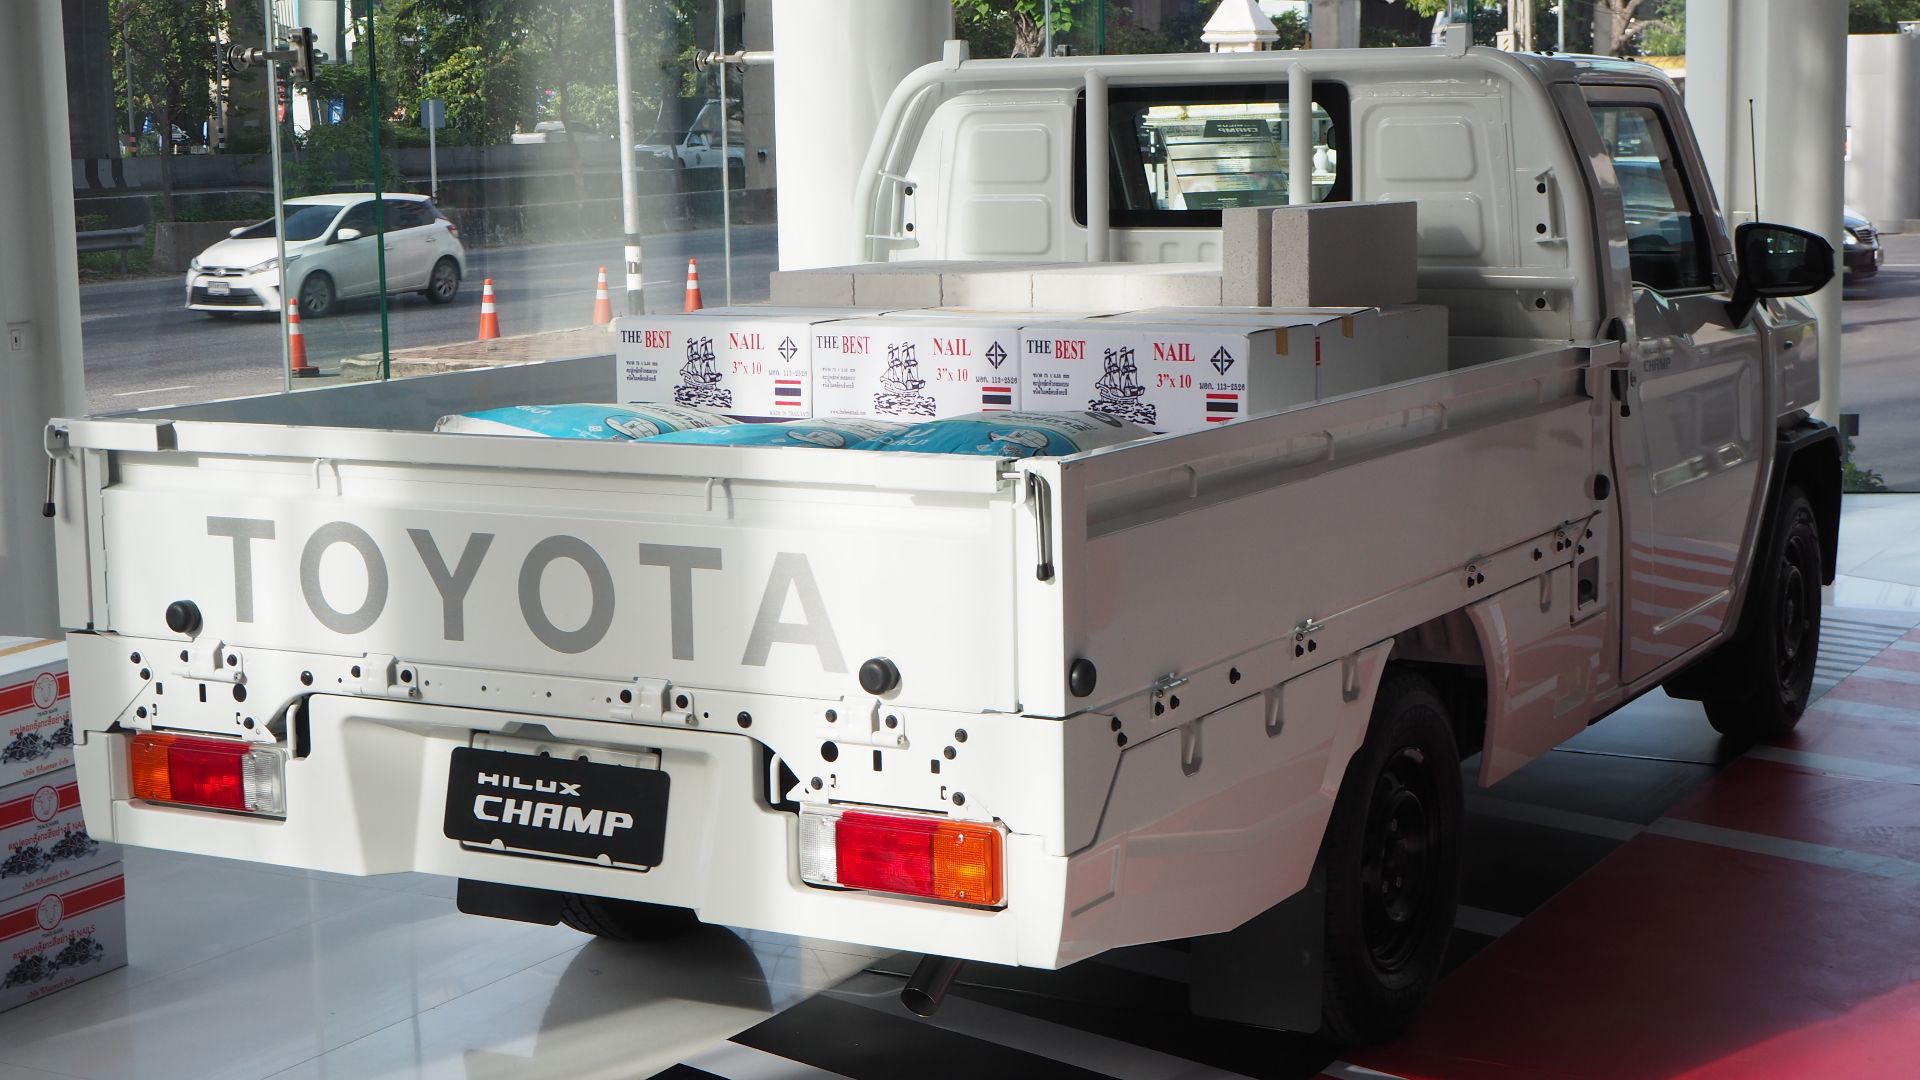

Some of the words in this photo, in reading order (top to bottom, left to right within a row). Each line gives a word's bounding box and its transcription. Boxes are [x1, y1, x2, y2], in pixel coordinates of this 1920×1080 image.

[621, 330, 642, 344] THE
[645, 331, 671, 348] BEST
[729, 333, 764, 350] NAIL
[816, 335, 839, 349] THE
[842, 336, 870, 354] BEST
[933, 338, 971, 356] NAIL
[1026, 339, 1051, 354] THE
[1055, 340, 1086, 360] BEST
[1153, 342, 1195, 362] NAIL
[1643, 357, 1672, 372] CHAMP
[1179, 374, 1192, 388] 10
[206, 515, 849, 674] TOYOTA
[477, 771, 582, 797] HILUX
[473, 794, 634, 837] CHAMP
